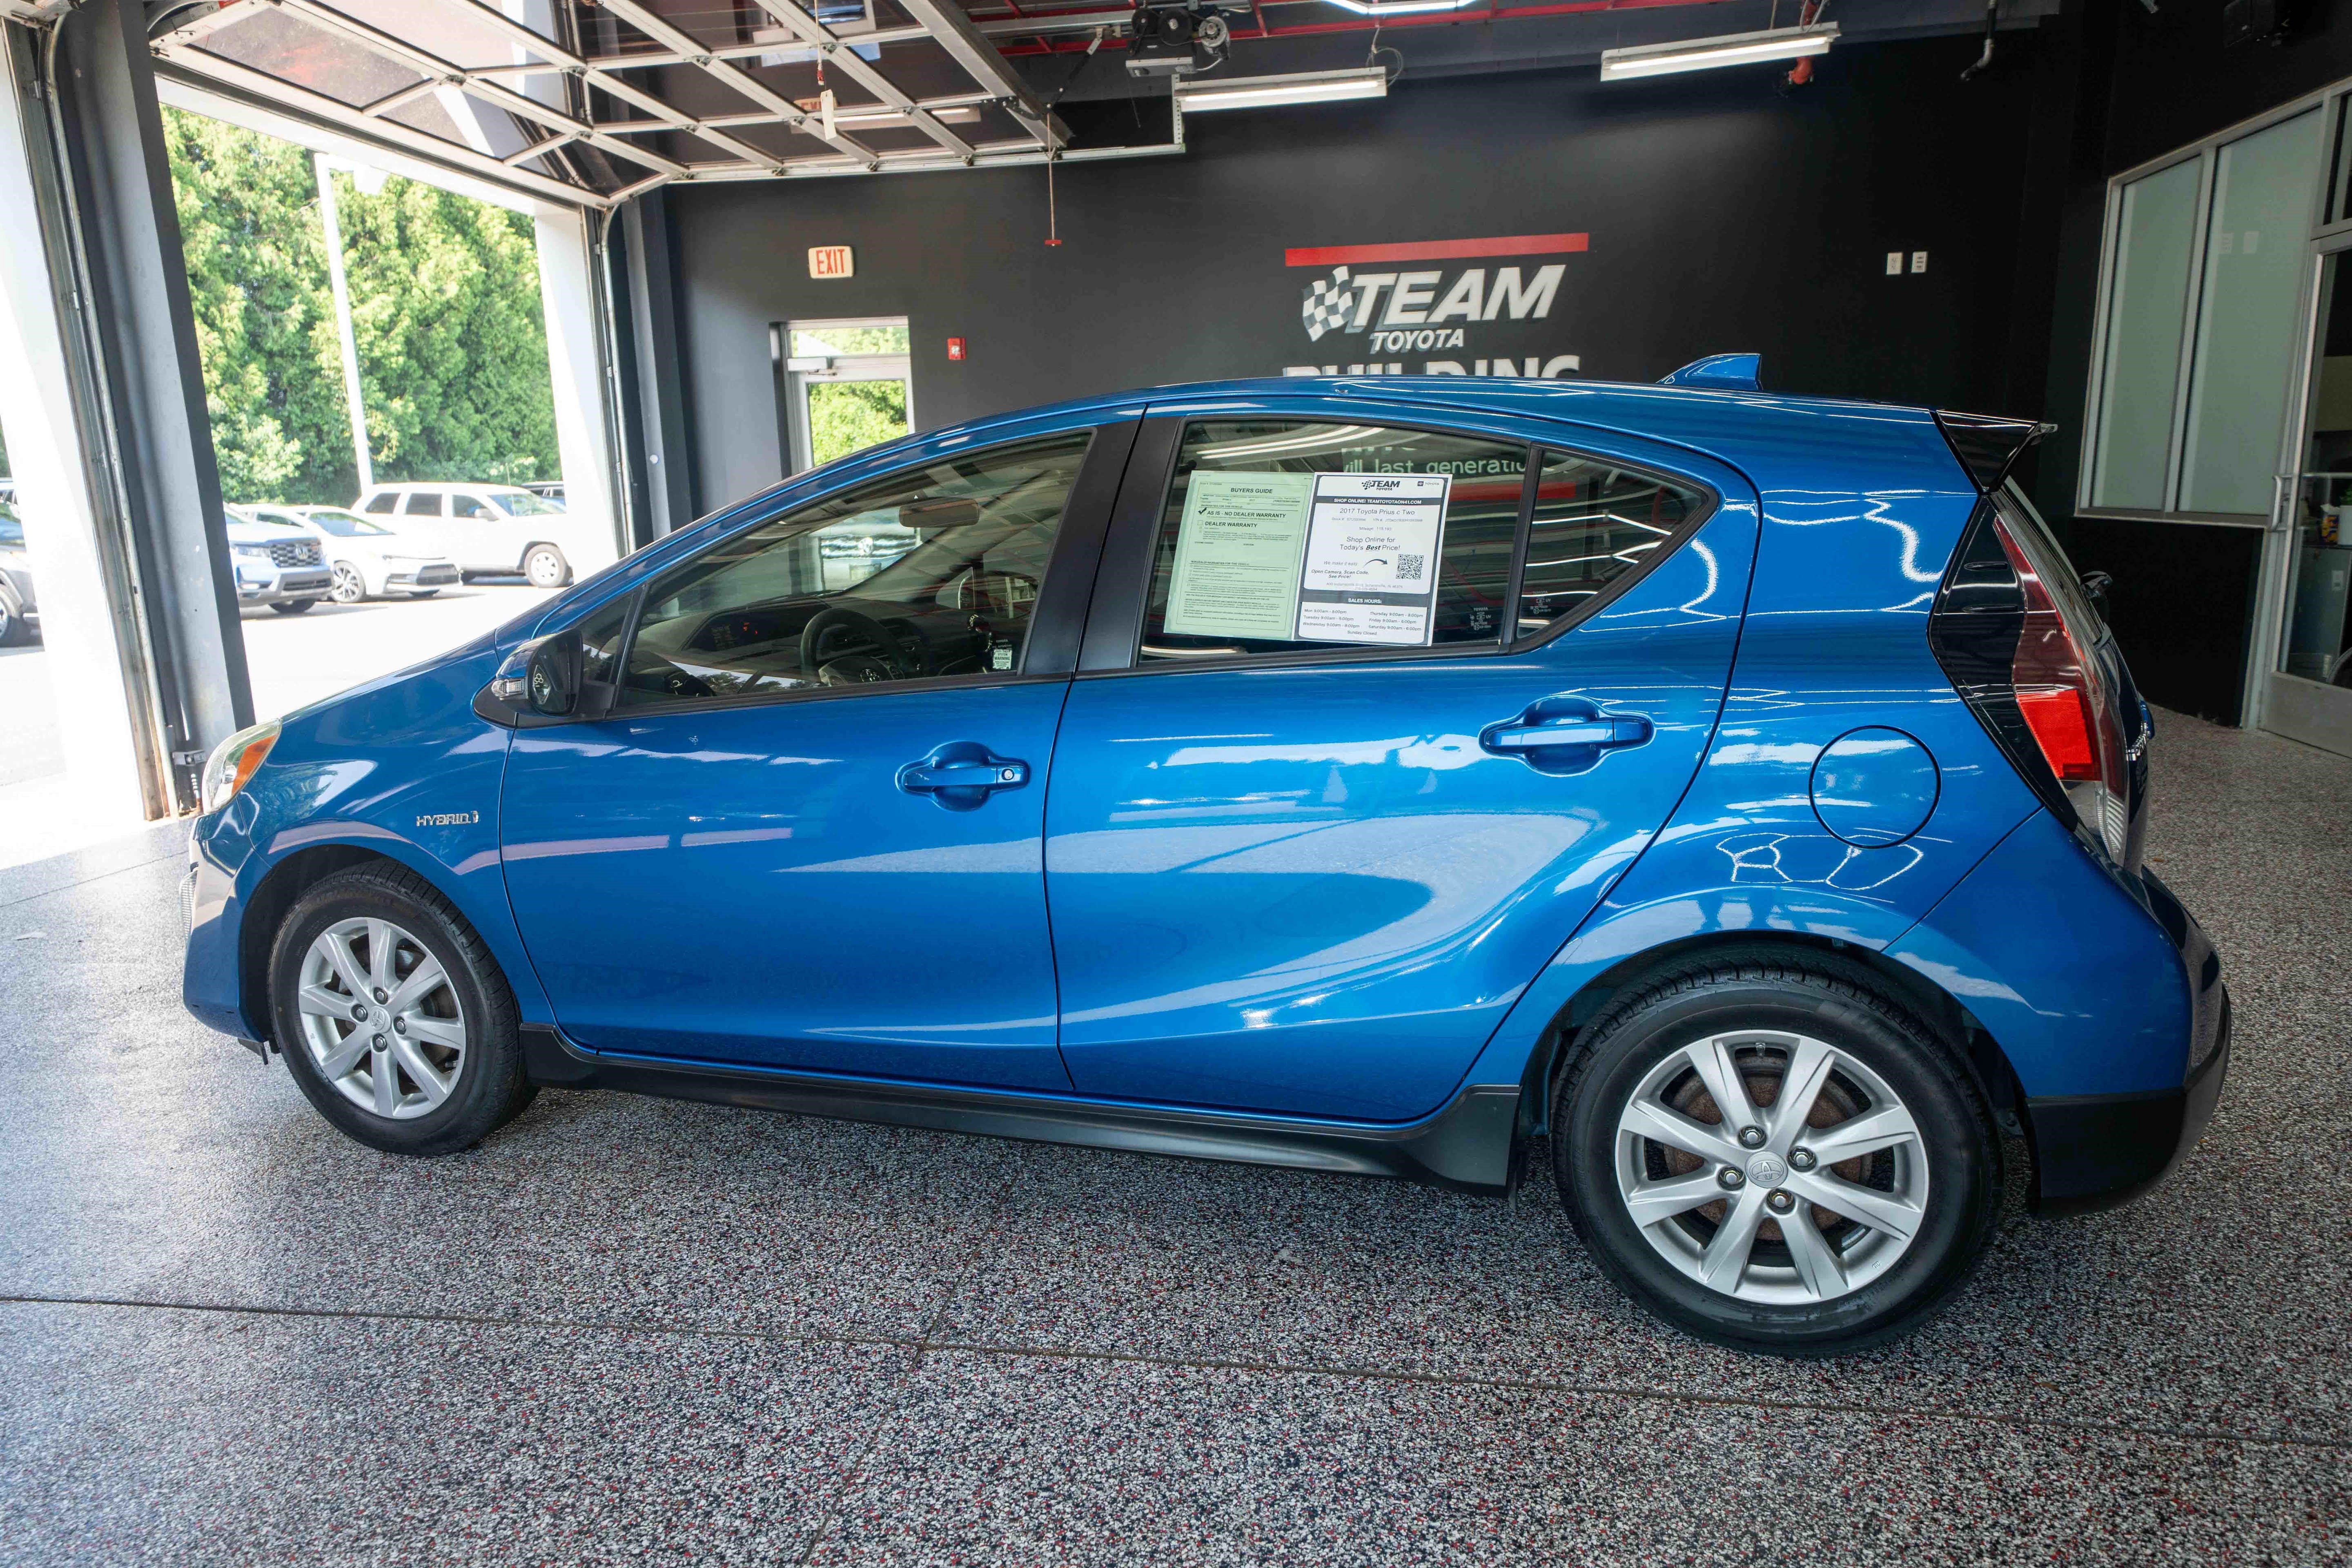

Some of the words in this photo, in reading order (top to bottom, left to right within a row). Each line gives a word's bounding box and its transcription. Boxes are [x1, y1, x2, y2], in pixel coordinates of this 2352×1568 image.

[816, 248, 845, 274] EXIT
[1351, 264, 1566, 327] TEAM
[1372, 329, 1465, 352] TOYOTA
[1375, 459, 1414, 473] last
[416, 813, 470, 826] HYBRID
